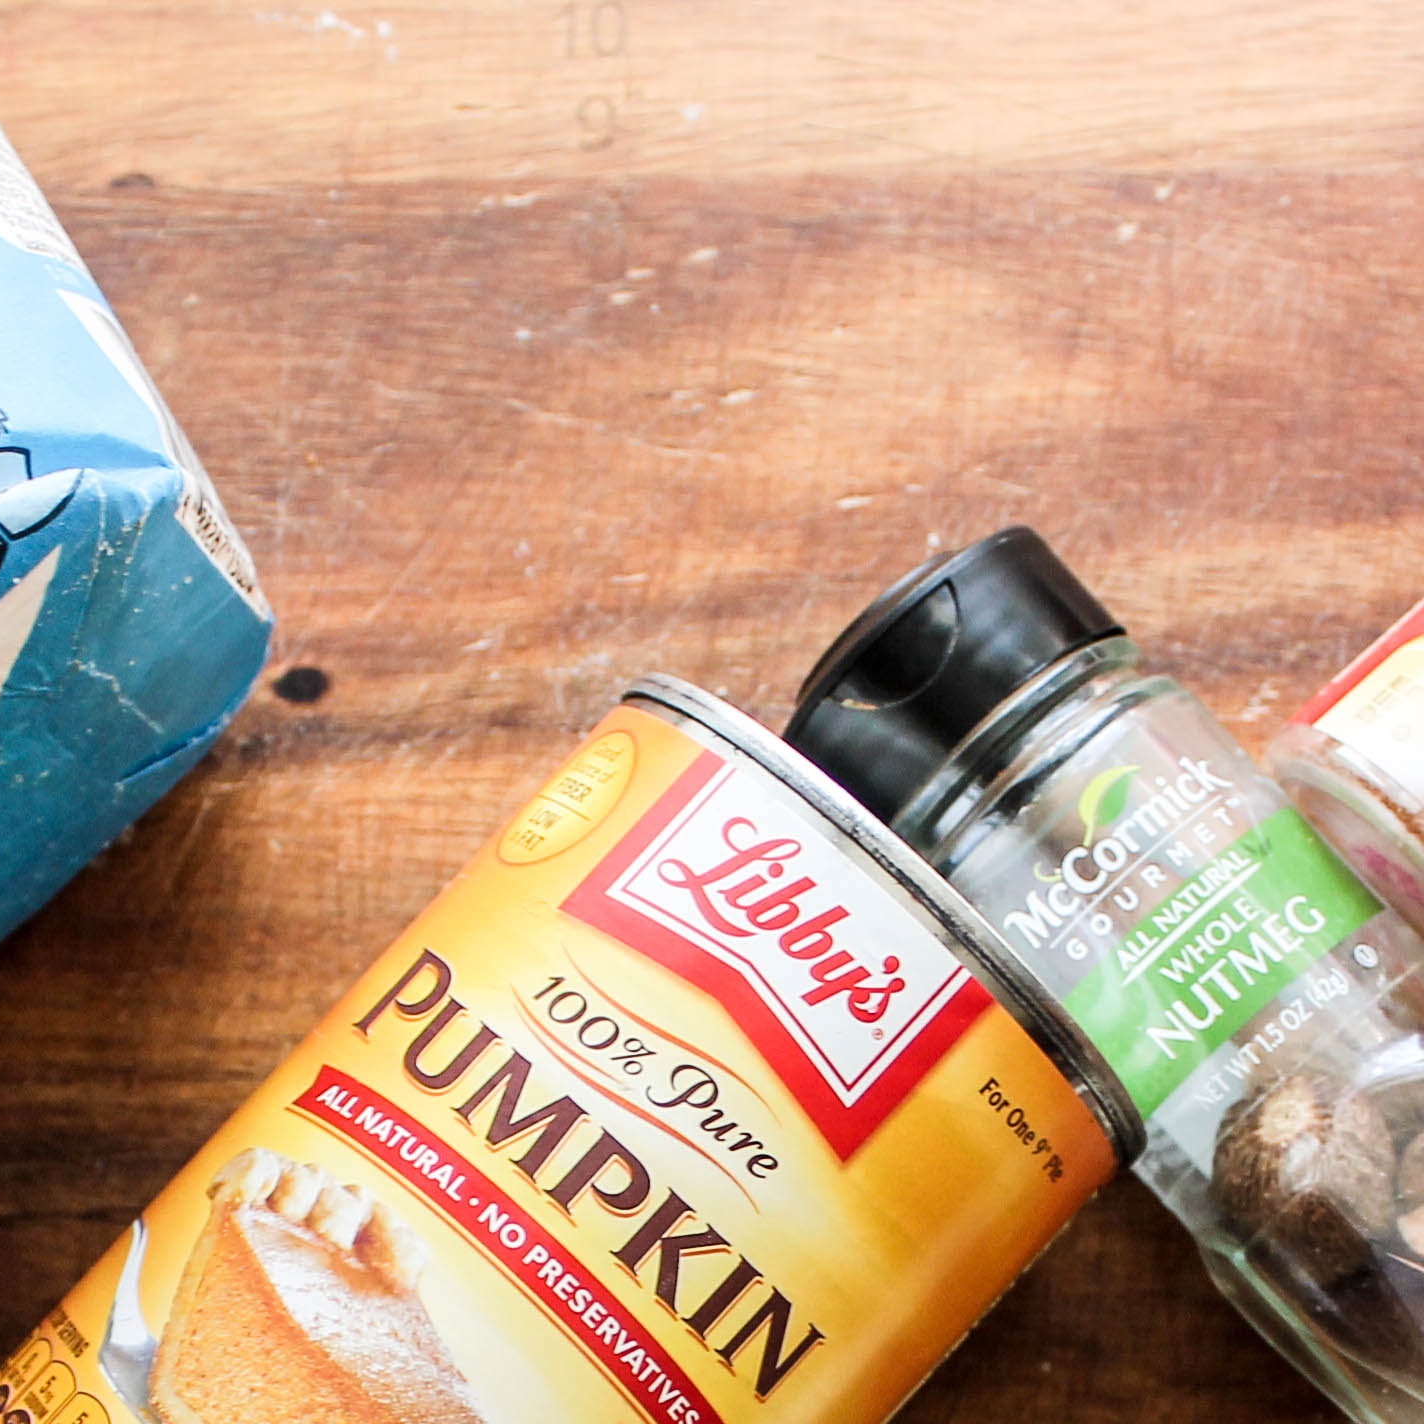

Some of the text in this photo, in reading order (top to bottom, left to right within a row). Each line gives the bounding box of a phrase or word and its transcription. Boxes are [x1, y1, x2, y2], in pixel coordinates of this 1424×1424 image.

[656, 812, 904, 1025] Libby's
[1002, 755, 1234, 950] McCormick
[1065, 807, 1236, 961] GOURMET
[1115, 850, 1253, 971] ALL NATURAL
[1146, 894, 1328, 1061] NUTMEG
[1159, 895, 1260, 984] WHOLE
[529, 973, 782, 1180] 100% Pure
[978, 1076, 1011, 1113] For
[1005, 1107, 1036, 1146] One
[1192, 1072, 1233, 1112] NET
[1224, 1042, 1262, 1075] WT
[1254, 1022, 1287, 1056] 1.5
[1277, 998, 1315, 1032] OZ
[315, 1082, 360, 1121] ALL
[351, 1106, 468, 1204] NATURAL
[476, 1200, 530, 1250] NO
[352, 948, 830, 1402] PUMPKIN
